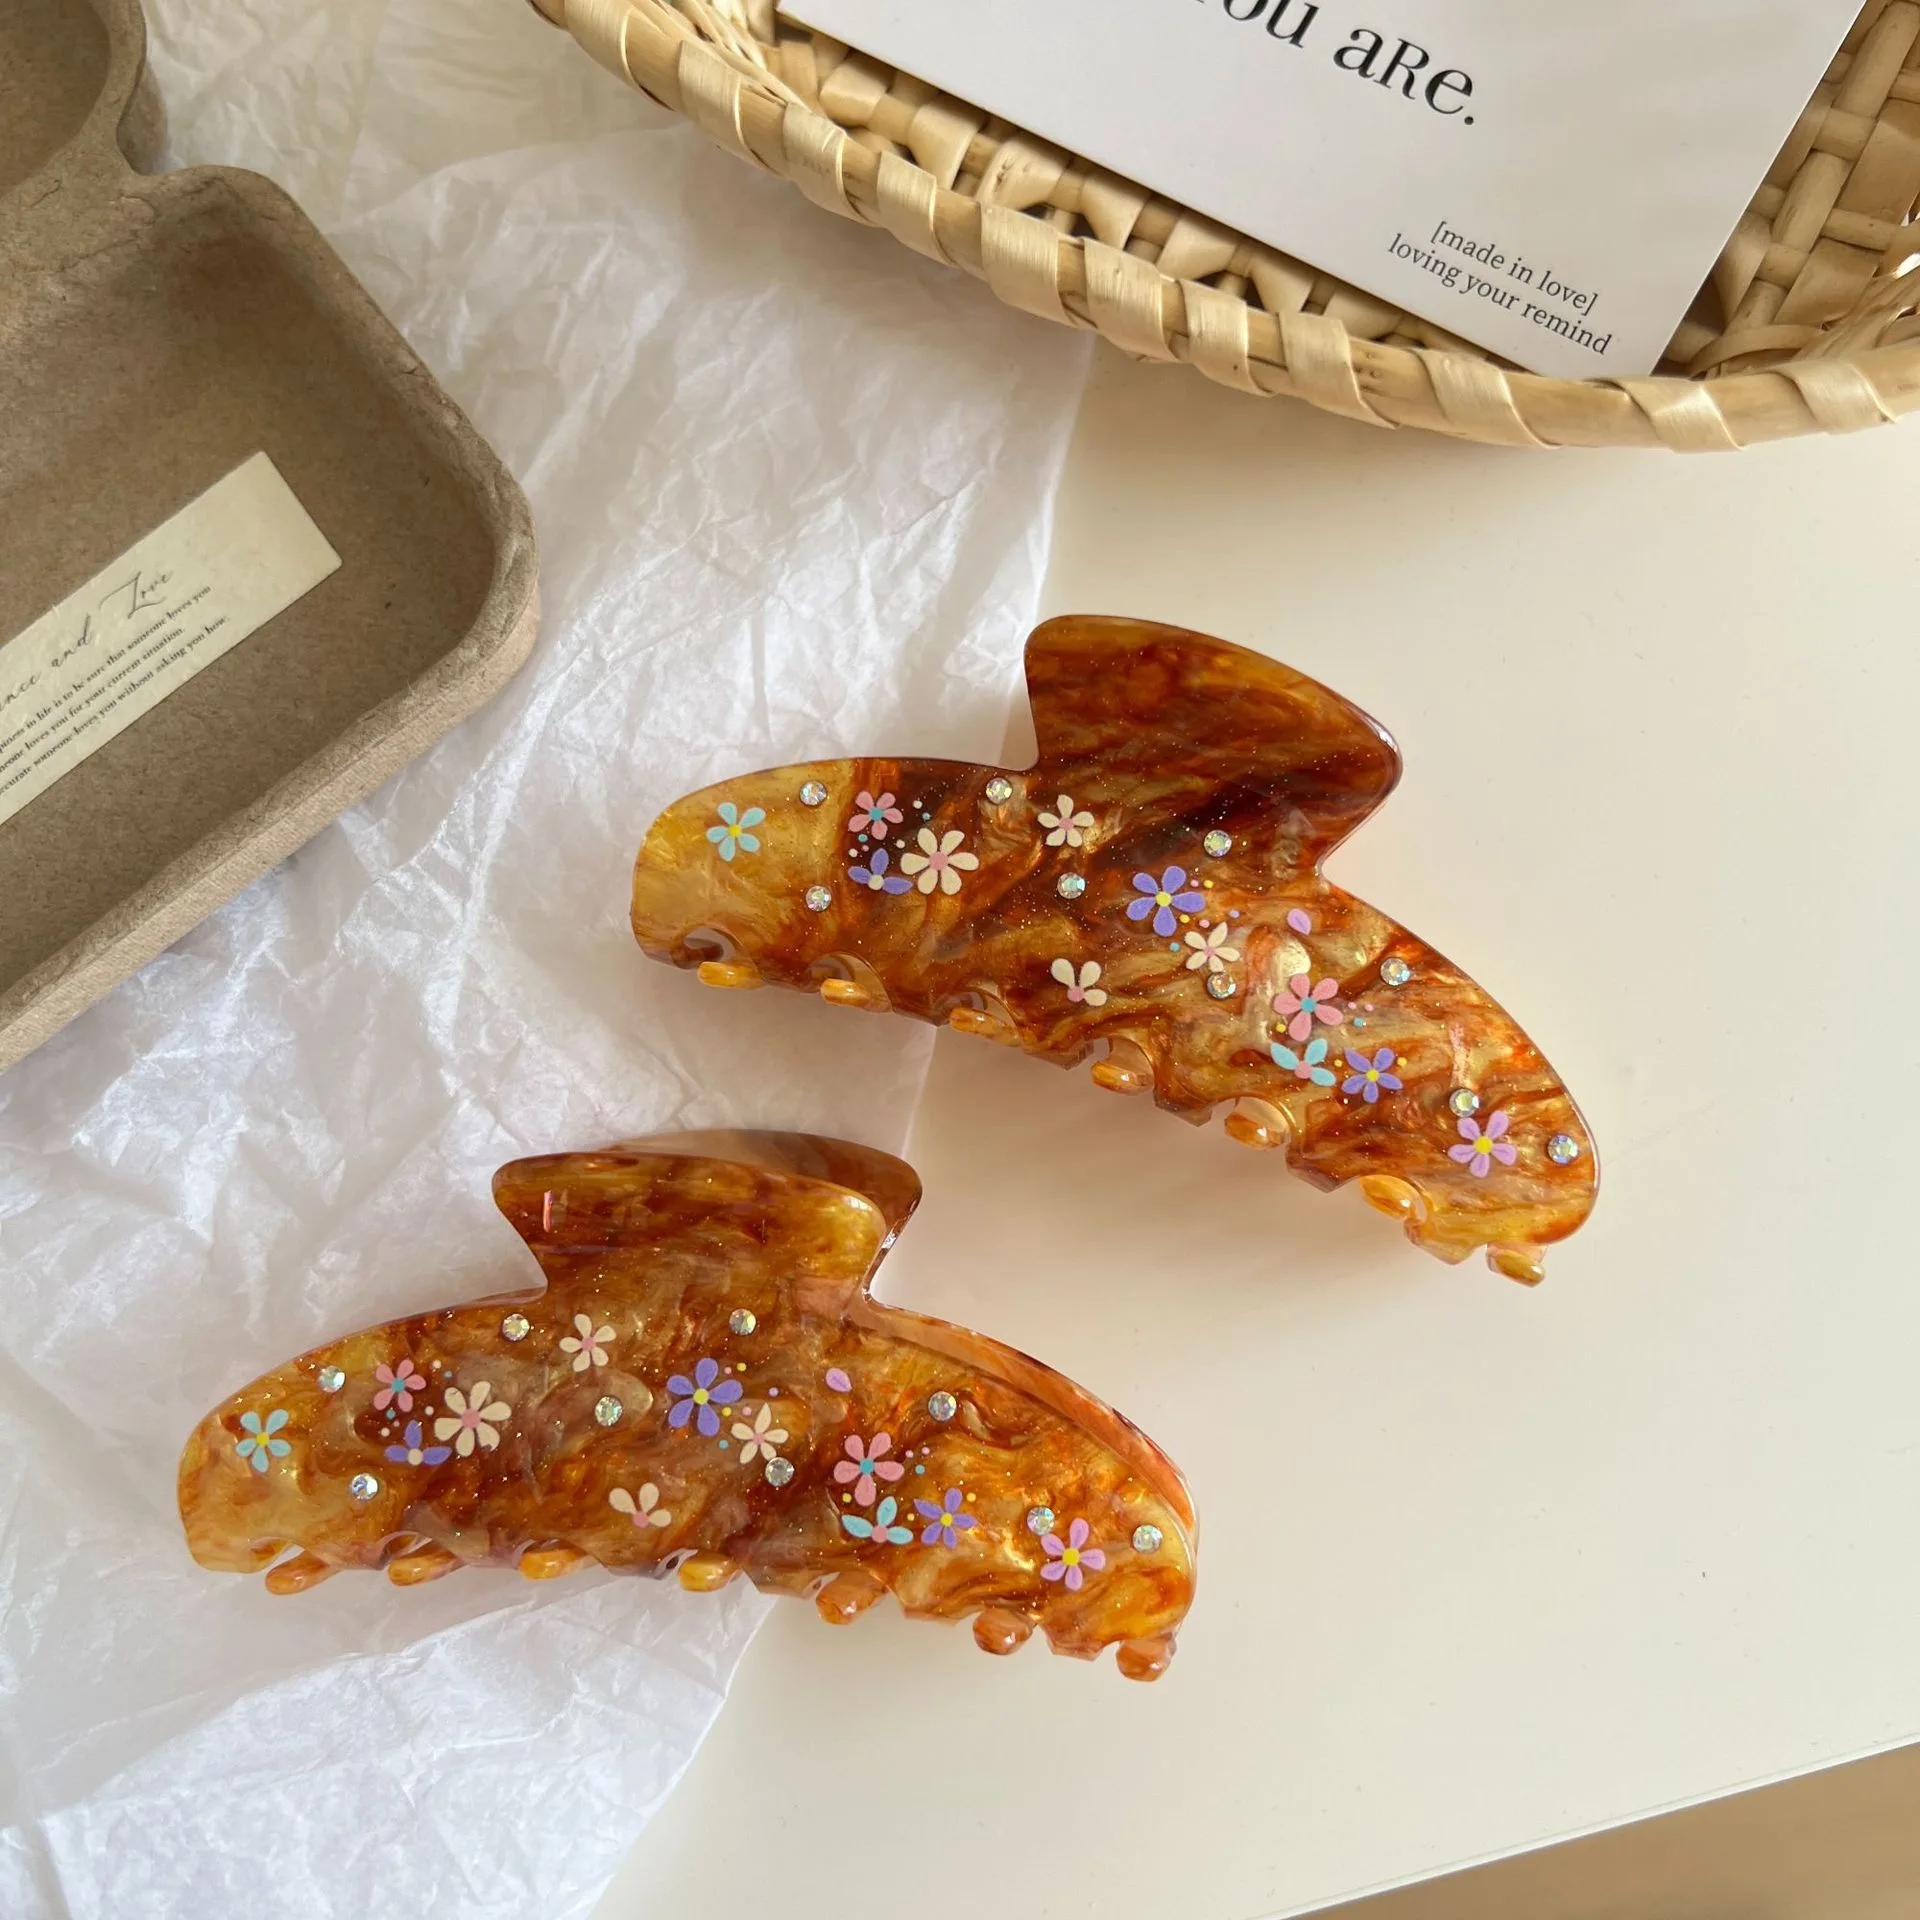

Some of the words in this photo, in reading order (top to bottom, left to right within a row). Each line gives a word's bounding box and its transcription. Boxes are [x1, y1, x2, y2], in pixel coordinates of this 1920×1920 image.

[1388, 233, 1462, 288] loving
[1459, 274, 1520, 311] your
[1520, 301, 1613, 355] remind
[1430, 221, 1505, 269] [made
[1507, 257, 1533, 284] in
[1536, 271, 1598, 317] love]
[106, 648, 126, 666] that
[127, 618, 167, 650] someone
